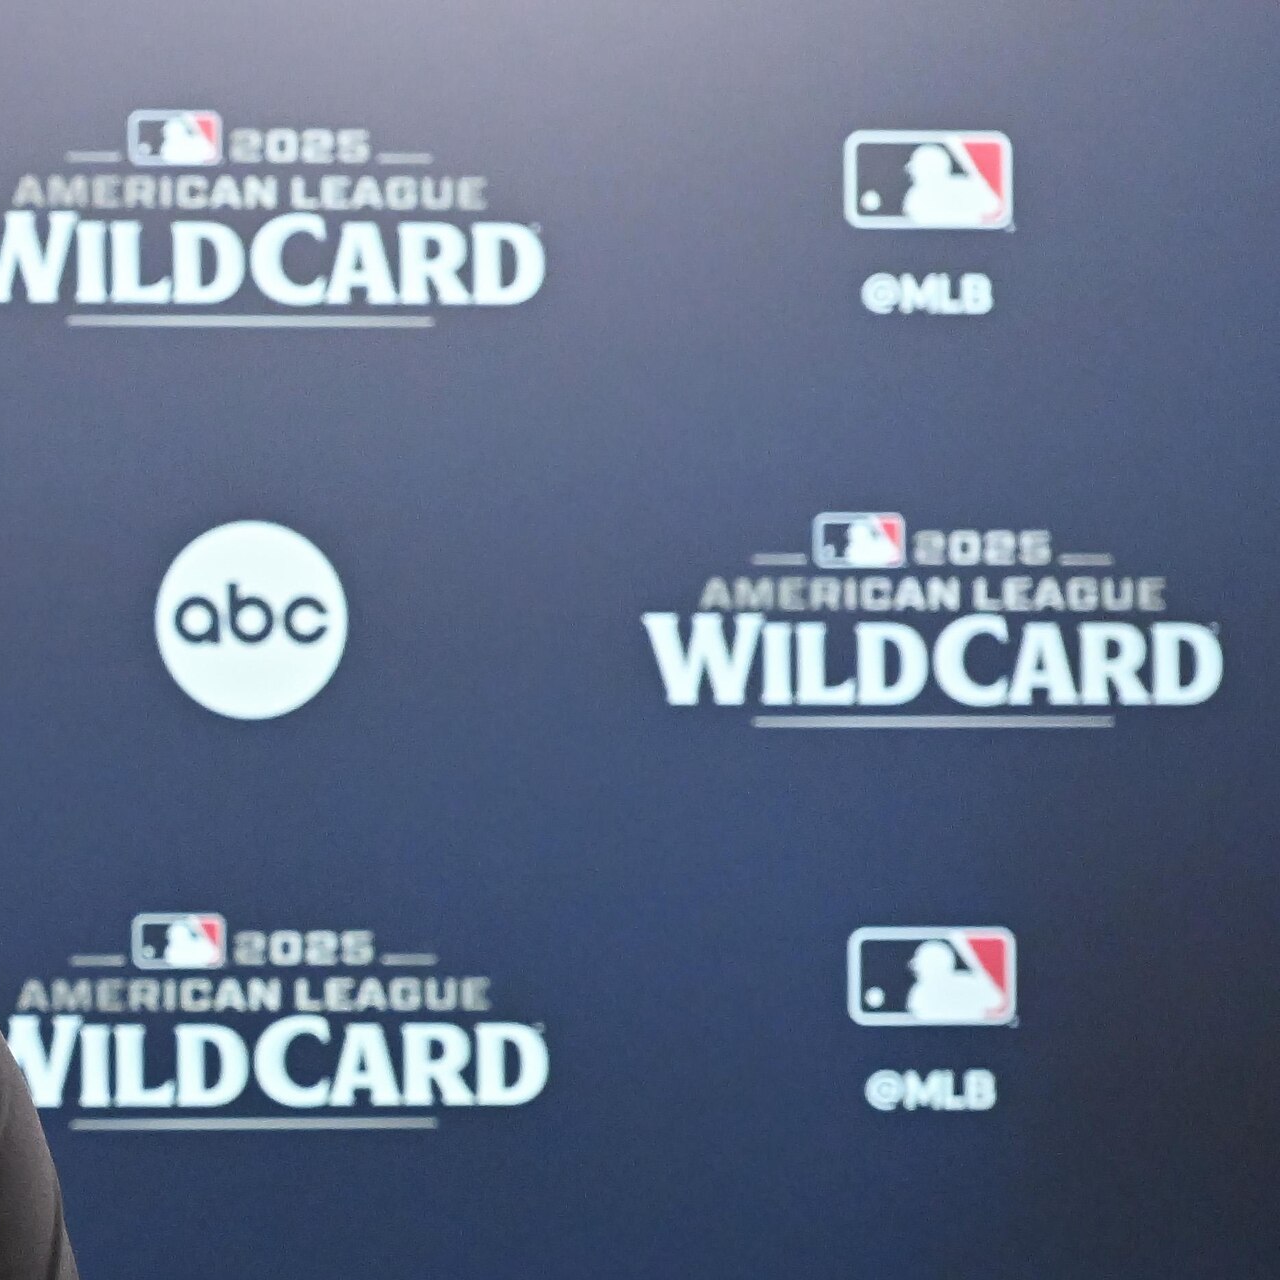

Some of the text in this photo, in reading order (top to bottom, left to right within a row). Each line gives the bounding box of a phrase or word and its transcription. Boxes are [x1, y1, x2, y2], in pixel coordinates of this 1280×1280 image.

[230, 128, 370, 163] 2025
[12, 174, 487, 211] AMERICAN LEAGUE
[861, 273, 993, 314] @MLB
[914, 530, 1051, 565] 2025
[698, 577, 1166, 611] AMERICAN LEAGUE
[174, 583, 327, 645] abc
[234, 930, 373, 966] 2025
[19, 977, 490, 1012] AMERICAN LEAGUE
[865, 1070, 996, 1111] @MLB
